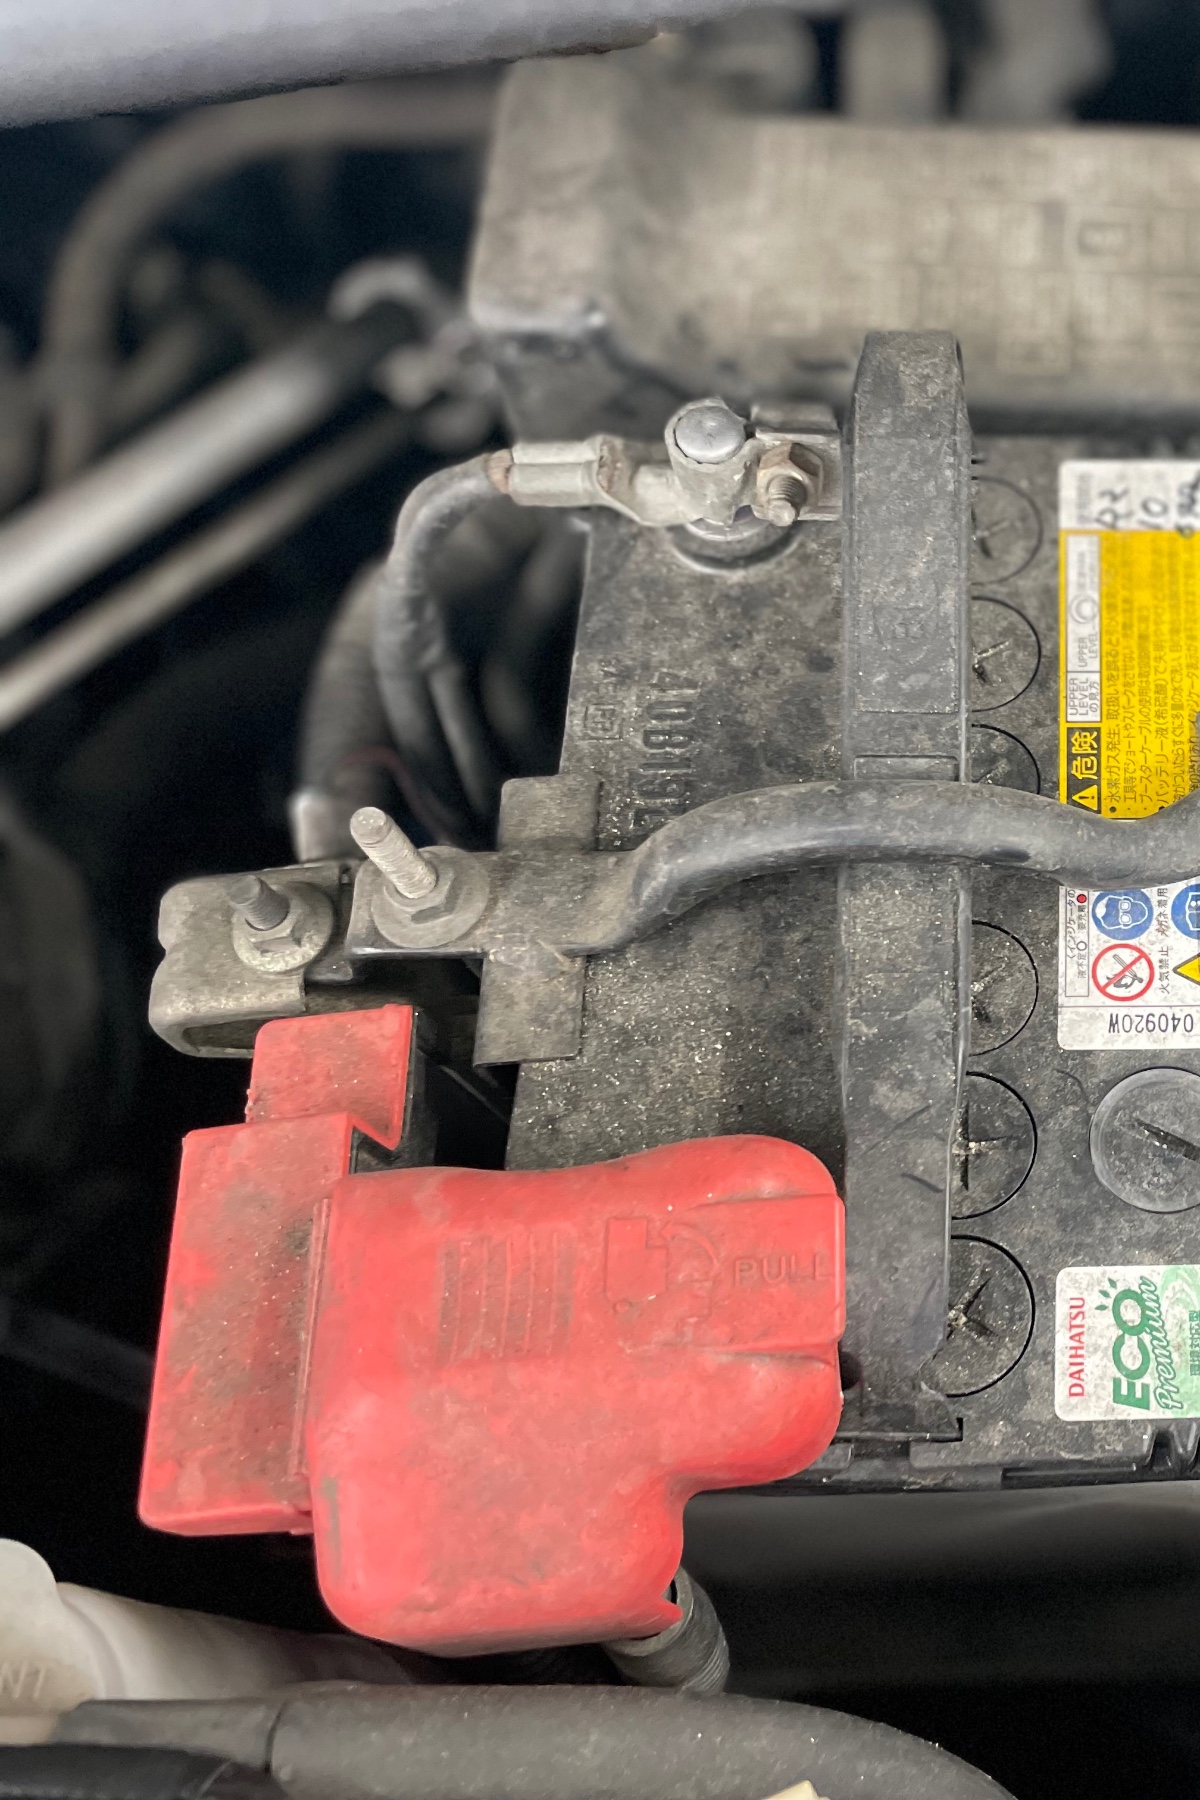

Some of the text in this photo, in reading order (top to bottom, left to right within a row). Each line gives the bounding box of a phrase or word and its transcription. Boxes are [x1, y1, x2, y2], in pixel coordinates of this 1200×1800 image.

[1077, 637, 1089, 668] UPPER
[1089, 631, 1098, 659] LEVEL
[1069, 677, 1079, 716] UPPER
[1079, 680, 1089, 716] LEVEL
[1089, 681, 1100, 713] の見方
[1071, 730, 1099, 780] 危険
[1157, 887, 1169, 937] メガネ着用
[1157, 945, 1170, 994] 火気禁止
[1108, 1012, 1194, 1033] 040920W
[734, 1254, 834, 1288] PULL
[1068, 1297, 1085, 1398] DAIHATSU
[1112, 1288, 1151, 1410] ECO
[1139, 1276, 1185, 1410] Premium
